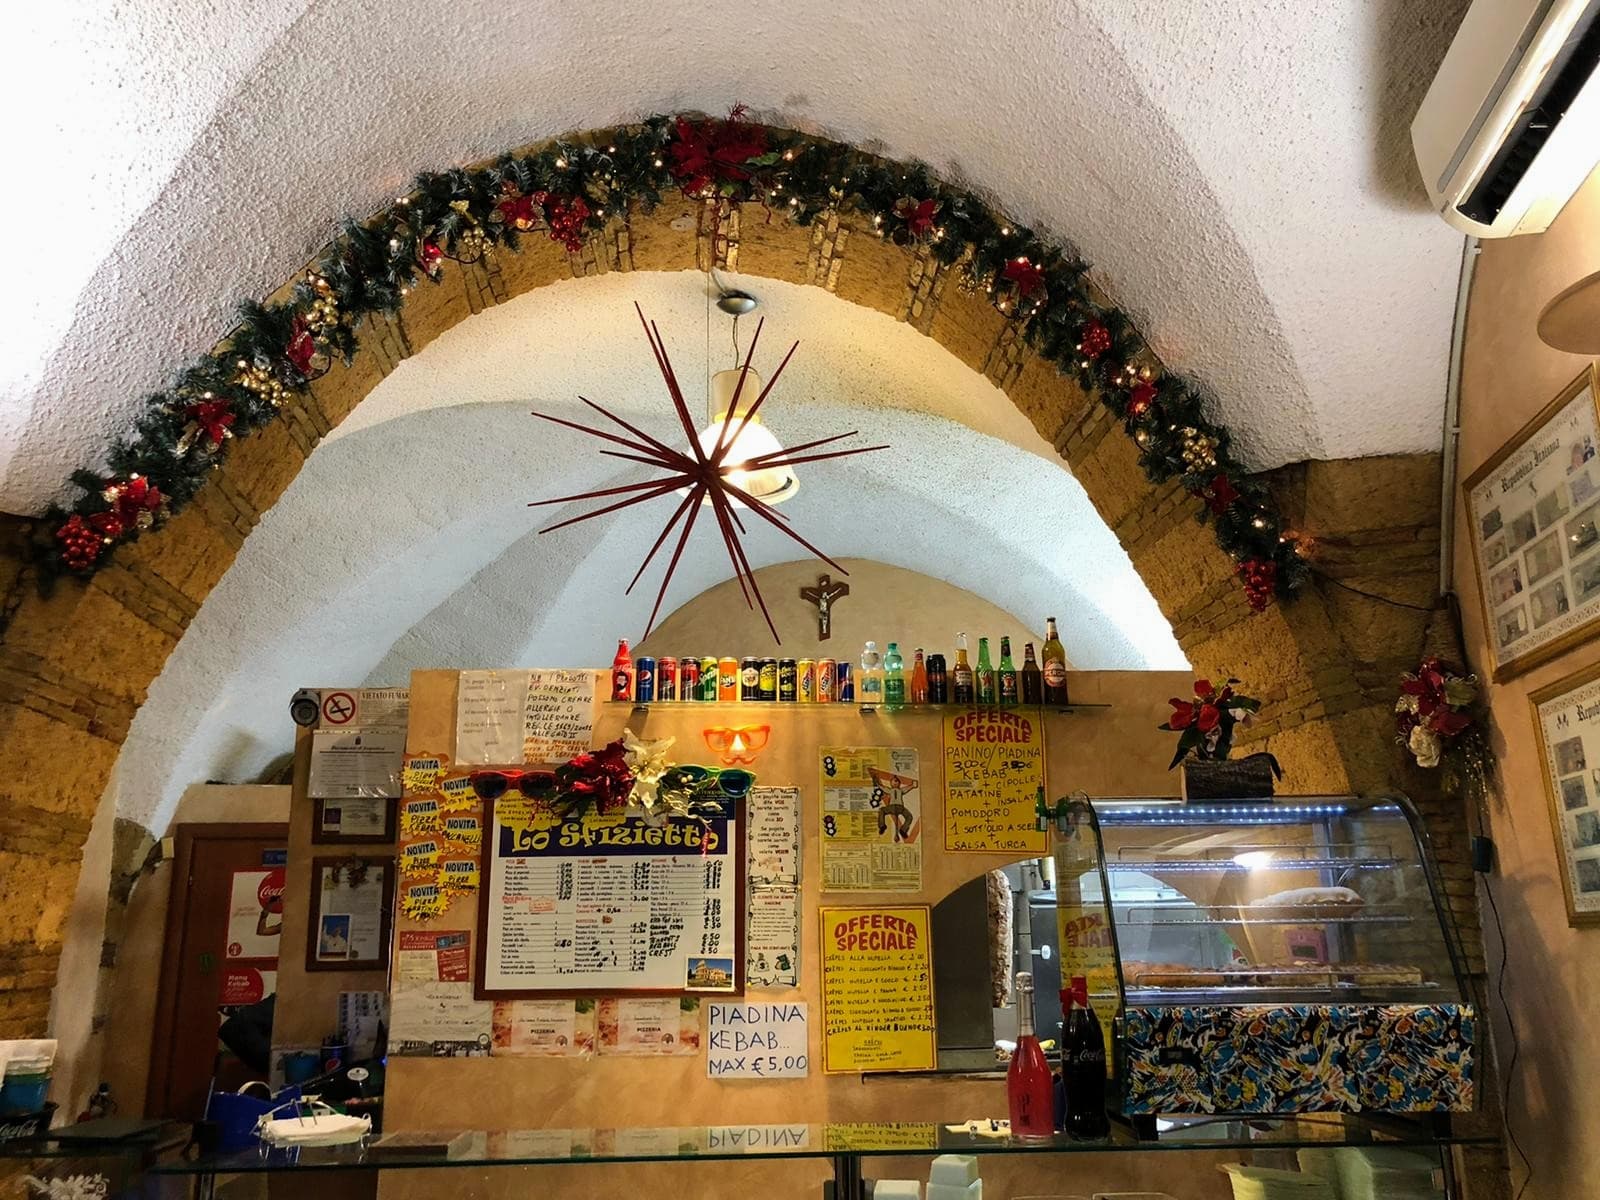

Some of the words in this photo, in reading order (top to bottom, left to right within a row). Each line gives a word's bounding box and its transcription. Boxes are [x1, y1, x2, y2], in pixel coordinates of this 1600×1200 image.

[954, 711, 1032, 734] OFFERTA
[956, 725, 1031, 743] SPECIALE
[963, 768, 1007, 780] KEBAB
[950, 789, 1001, 798] PATATINE
[998, 793, 1036, 806] INSALAT
[512, 826, 550, 852] Lo
[954, 841, 987, 849] SALSA
[995, 841, 1027, 849] TURCA
[834, 915, 919, 939] OFFERTA
[836, 931, 916, 950] SPECIALE
[709, 1004, 805, 1025] PIADINA
[709, 1057, 746, 1074] MAX
